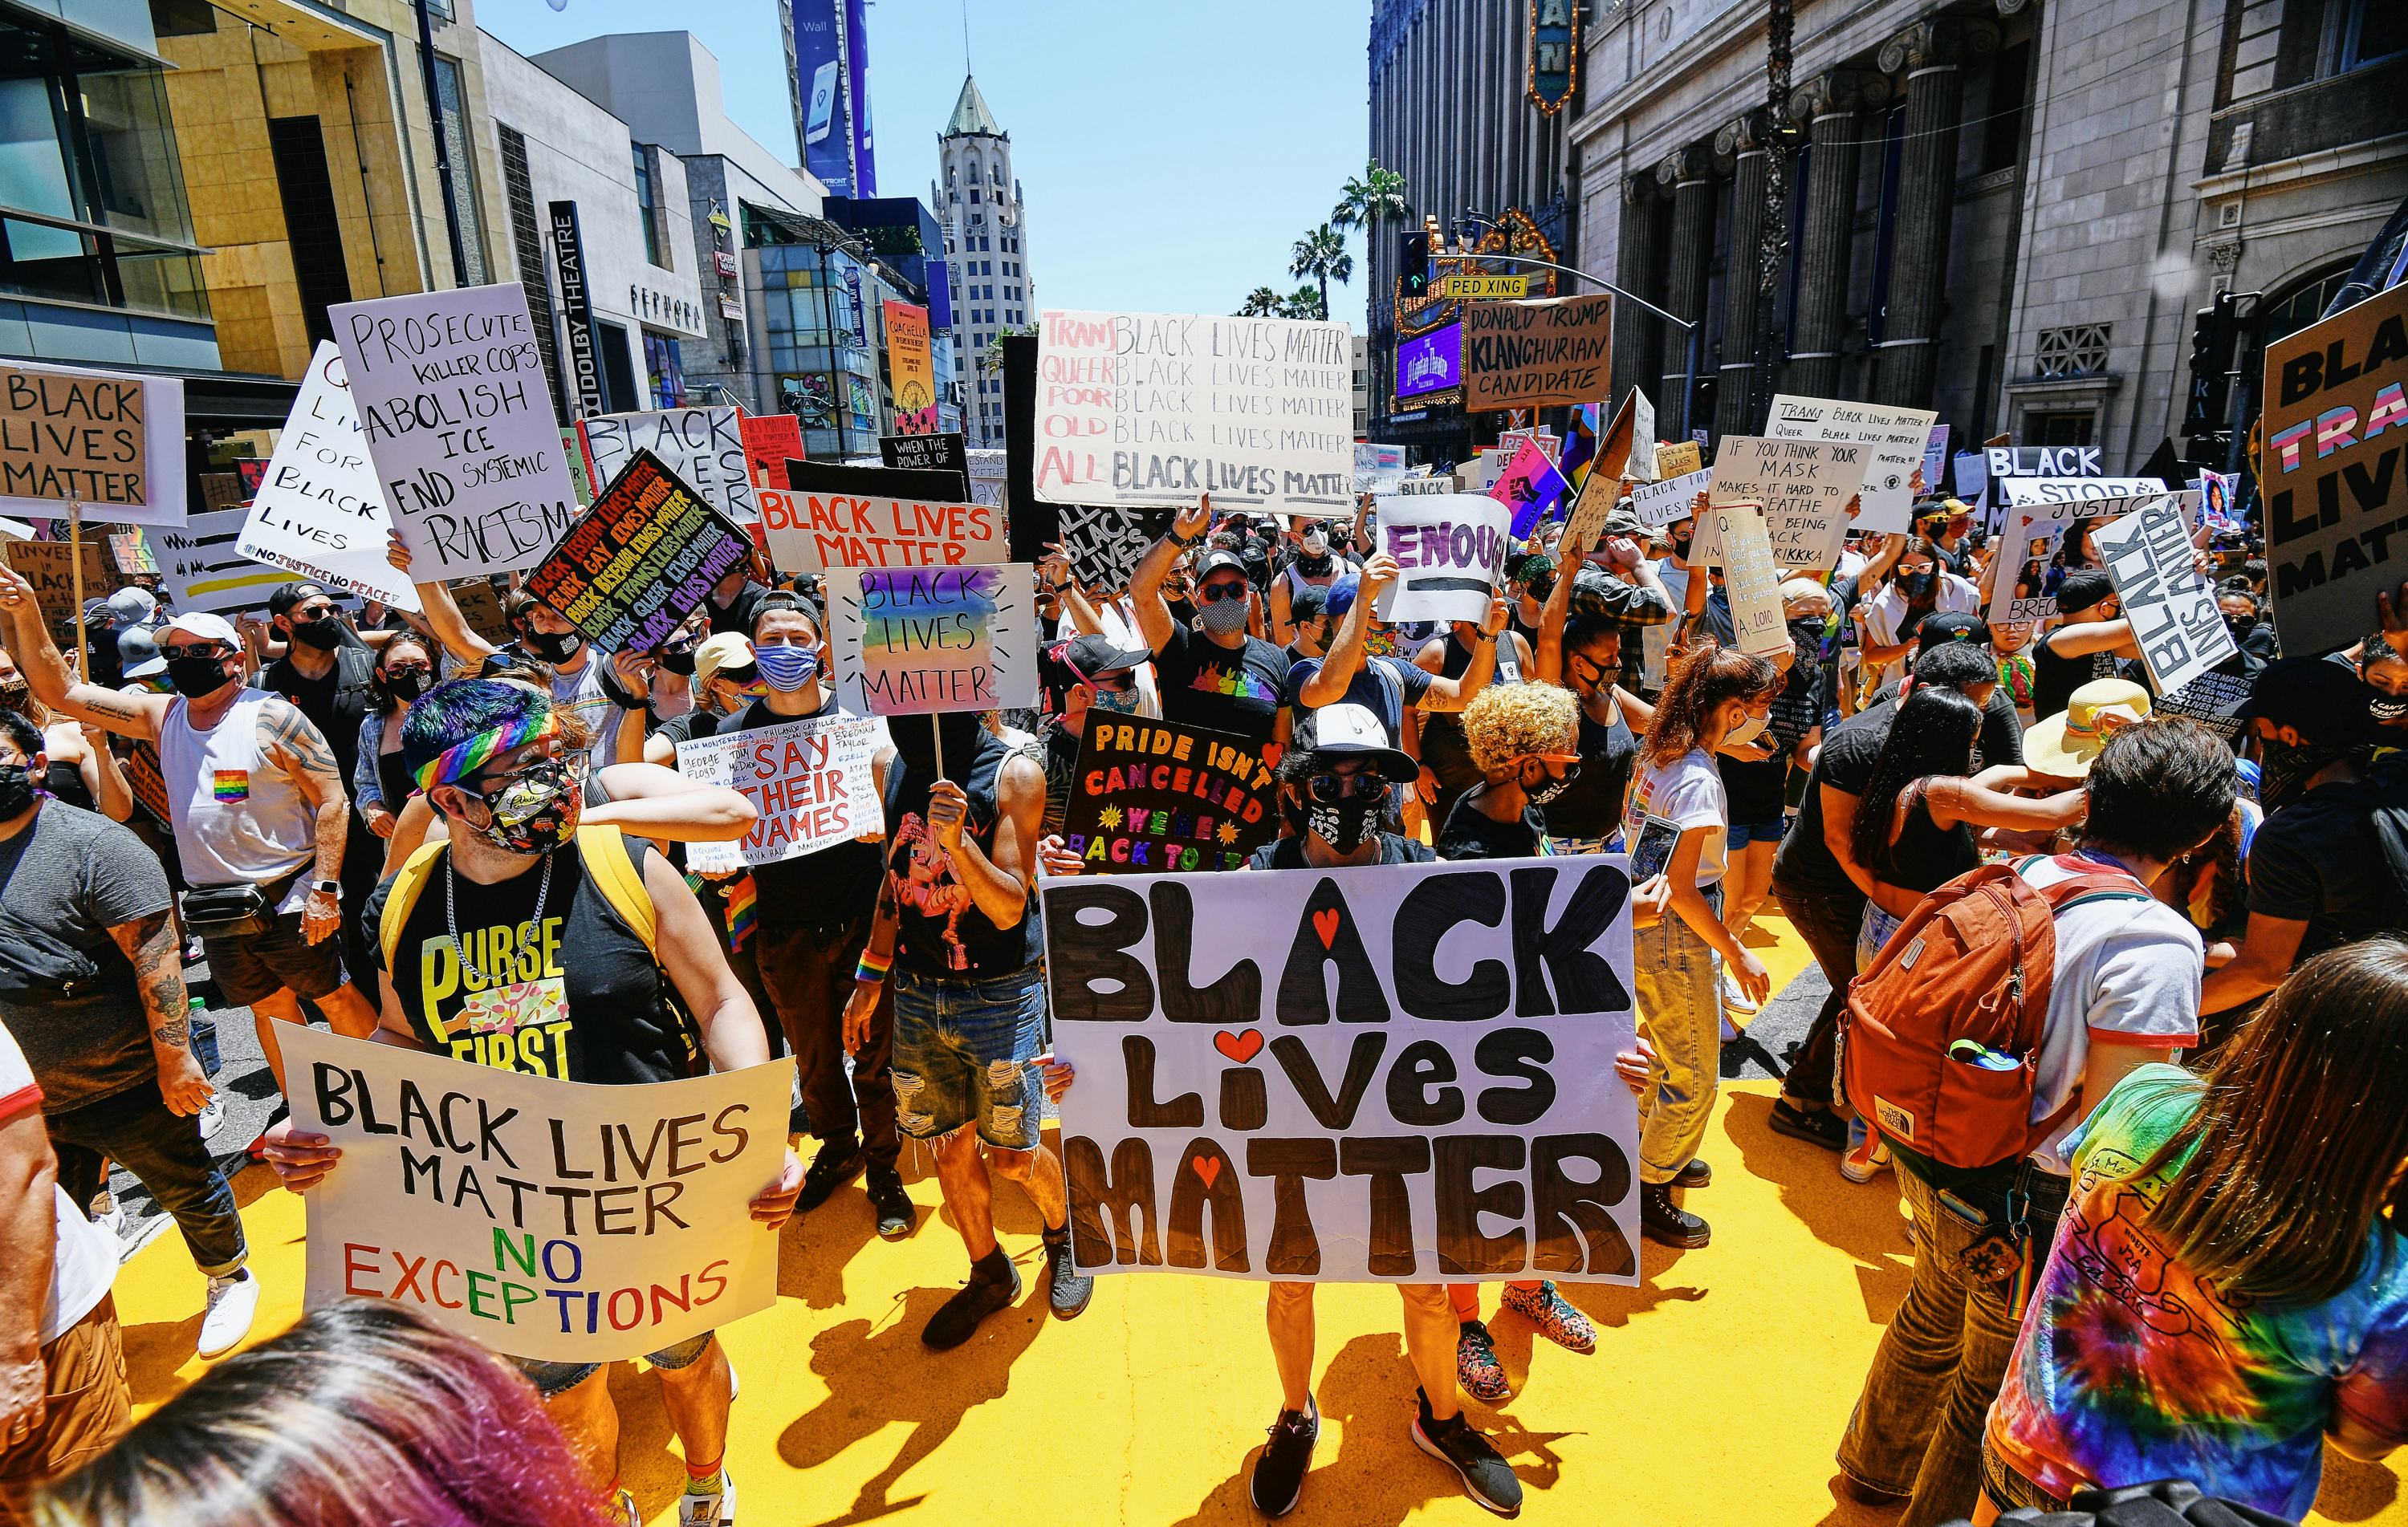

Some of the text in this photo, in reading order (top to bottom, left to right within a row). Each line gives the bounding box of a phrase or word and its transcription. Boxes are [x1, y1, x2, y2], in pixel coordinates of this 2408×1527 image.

[803, 21, 827, 32] Wall
[555, 215, 596, 390] DOLBY THEATRE
[630, 283, 700, 327] SEPHORA
[849, 289, 857, 303] PLAY
[1451, 279, 1521, 294] PED XING
[852, 309, 860, 328] DRINK
[890, 321, 927, 338] COACHELLA
[1471, 300, 1609, 334] DONALD TRUMP
[350, 313, 527, 372] PROSECUTE
[1043, 312, 1344, 365] TRANS BLACK LIVES MATTER
[1471, 335, 1606, 373] KLANCHURIAN
[412, 342, 539, 385] KILLER COPS
[1042, 354, 1346, 392] QUEER BLACK LIVES MATTER
[1479, 366, 1601, 396] CANDIDATE
[7, 374, 141, 424] BLACK
[364, 381, 528, 444] ABOLISH
[1047, 387, 1344, 418] POOR BLACK LIVES MATTER
[1780, 404, 1890, 425] TRANS BLACK LIVES
[2, 419, 136, 462] LIVES
[437, 426, 494, 459] ICE
[584, 410, 744, 464] BLACK
[764, 419, 794, 433] MATTER
[1044, 415, 1108, 438] OLD
[1114, 415, 1195, 443] BLACK
[1212, 424, 1273, 450] LIVES
[1281, 429, 1347, 453] MATTER
[1775, 424, 1881, 442] QUEER BLACK LIVES
[295, 431, 364, 473] FOR
[894, 438, 949, 454] WHEN THE
[897, 454, 929, 469] POWER
[936, 452, 950, 465] OF
[975, 456, 1003, 466] STAND
[1730, 440, 1857, 465] IF YOU THINK YOUR
[1988, 447, 2101, 477] BLACK
[2, 461, 144, 504] MATTER
[388, 451, 549, 515] END SYSTEMIC
[1037, 446, 1352, 496] ALL BLACK LIVES MATTER
[1402, 481, 1444, 495] BLACK
[1717, 481, 1839, 497] MAKES IT HARD TO
[1759, 461, 1819, 480] MASK
[274, 465, 380, 522] BLACK
[1634, 481, 1677, 502] BLACK
[259, 506, 348, 550] LIVES
[759, 491, 880, 535] BLACK
[891, 502, 992, 542] LIVES
[1639, 502, 1682, 523] LIVES
[1785, 517, 1827, 530] BEING
[422, 500, 570, 565] RACISM
[530, 490, 627, 598] BLACK LESBIAN LIVES
[547, 476, 674, 611] BLACK GAY LIVES MATTER
[814, 534, 968, 567] MATTER
[1065, 508, 1143, 564] BLACK
[565, 489, 691, 624] BLACK LIVES MATTER
[582, 503, 710, 639] BLACK TRANS LIVES MATTER
[1075, 529, 1151, 582] LIVES
[1385, 522, 1505, 583] ENOUGH
[599, 521, 725, 653] BLACK QUEER LIVES MATTER
[628, 607, 678, 652] BLACK
[670, 575, 712, 614] LIVES
[699, 534, 746, 583] MATTER
[859, 570, 986, 609] BLACK
[2140, 499, 2234, 668] LIVES MATTER
[1754, 610, 1772, 627] 1,010
[2102, 525, 2191, 680] BLACK
[883, 612, 975, 654] LIVES
[859, 666, 993, 712] MATTER
[2184, 700, 2211, 713] LIVES
[2187, 692, 2213, 705] LIVES
[2190, 684, 2216, 696] LIVES
[763, 717, 837, 739] PHILANDO CASTILLE
[2154, 701, 2244, 726] BLACK LIVES MATTER
[702, 733, 754, 749] MONTERROSA
[804, 729, 824, 737] BELL
[834, 725, 877, 741] BREONNA
[836, 738, 869, 752] TAYLOR
[730, 749, 749, 760] TONY
[755, 734, 829, 780] SAY
[838, 753, 866, 762] EZELL
[1096, 725, 1272, 790] PRIDE ISN'T
[723, 775, 749, 786] CLARK
[737, 770, 848, 816] THEIR
[1085, 762, 1263, 823] CANCELLED
[740, 802, 849, 851] NAMES
[1127, 806, 1214, 840] WE'RE
[746, 852, 766, 863] MYA
[770, 847, 788, 859] HALL
[1165, 843, 1243, 872] TO IT
[1043, 864, 1632, 1026] BLACK
[422, 916, 565, 1043] PURSE
[312, 1062, 750, 1182] BLACK LIVES
[1878, 1108, 1900, 1123] NORTH
[1885, 1117, 1900, 1130] FACE
[1887, 1107, 1900, 1118] THE
[401, 1146, 690, 1237] MATTER
[1064, 1133, 1636, 1277] MATTER
[493, 1228, 583, 1284] NO
[2119, 1245, 2142, 1274] J2A
[2124, 1228, 2152, 1259] ROUTE
[344, 1242, 730, 1334] EXCEPTIONS
[2109, 1280, 2145, 1316] 2016
